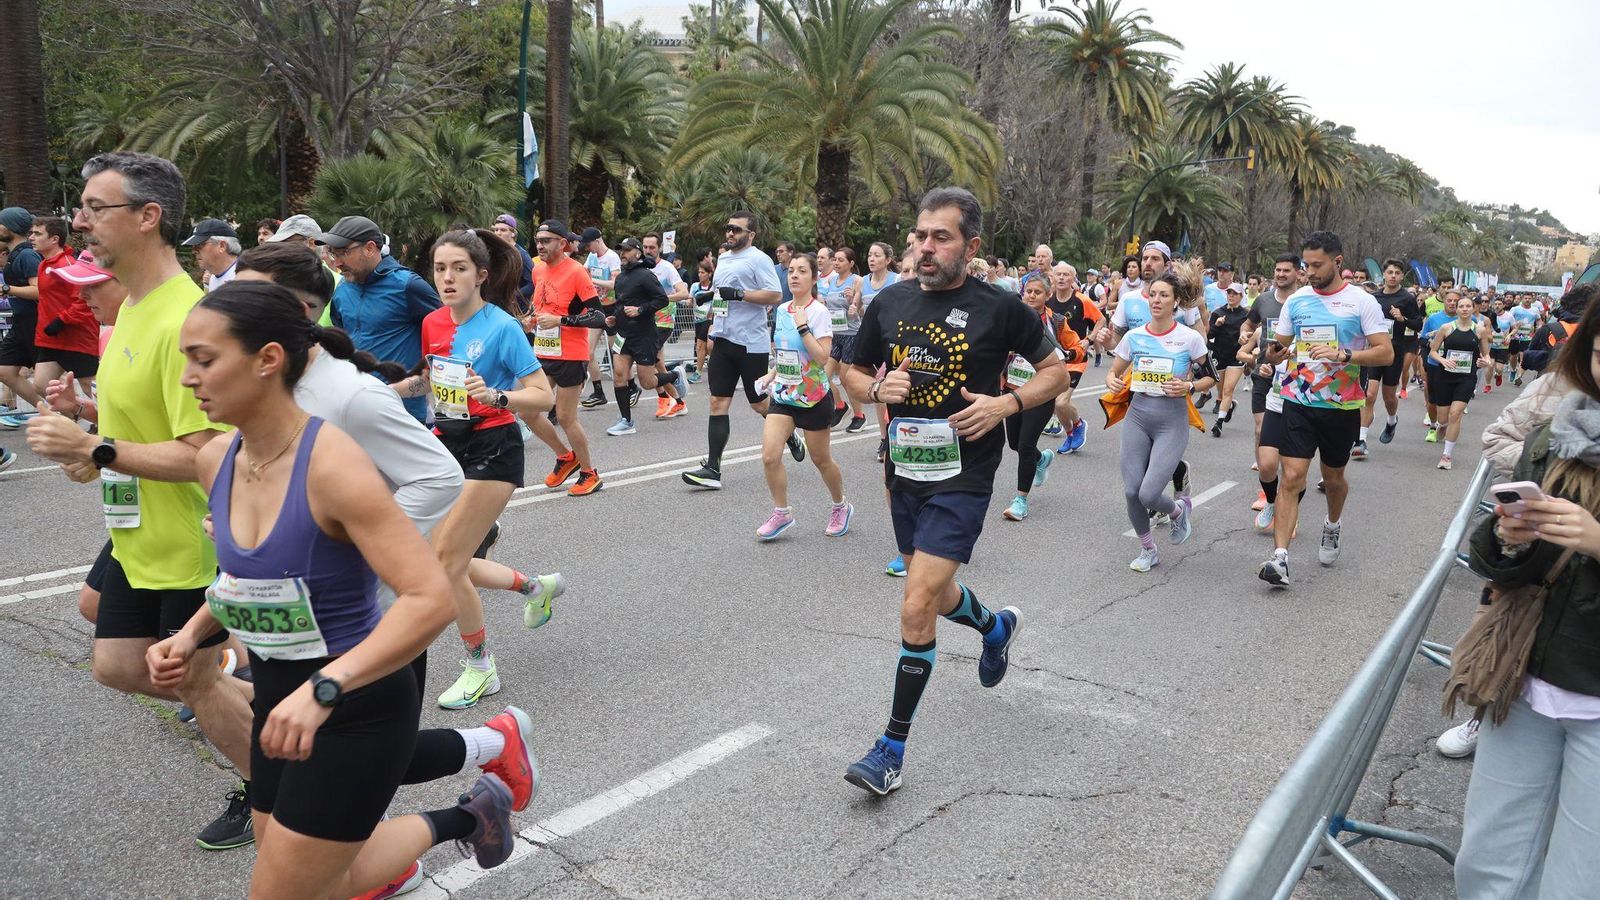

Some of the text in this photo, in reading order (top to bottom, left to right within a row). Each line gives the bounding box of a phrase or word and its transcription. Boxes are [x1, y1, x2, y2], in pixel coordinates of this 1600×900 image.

[538, 339, 556, 347] 3096
[1141, 372, 1166, 383] 3335
[903, 446, 948, 463] 4235
[226, 604, 294, 634] 5853
